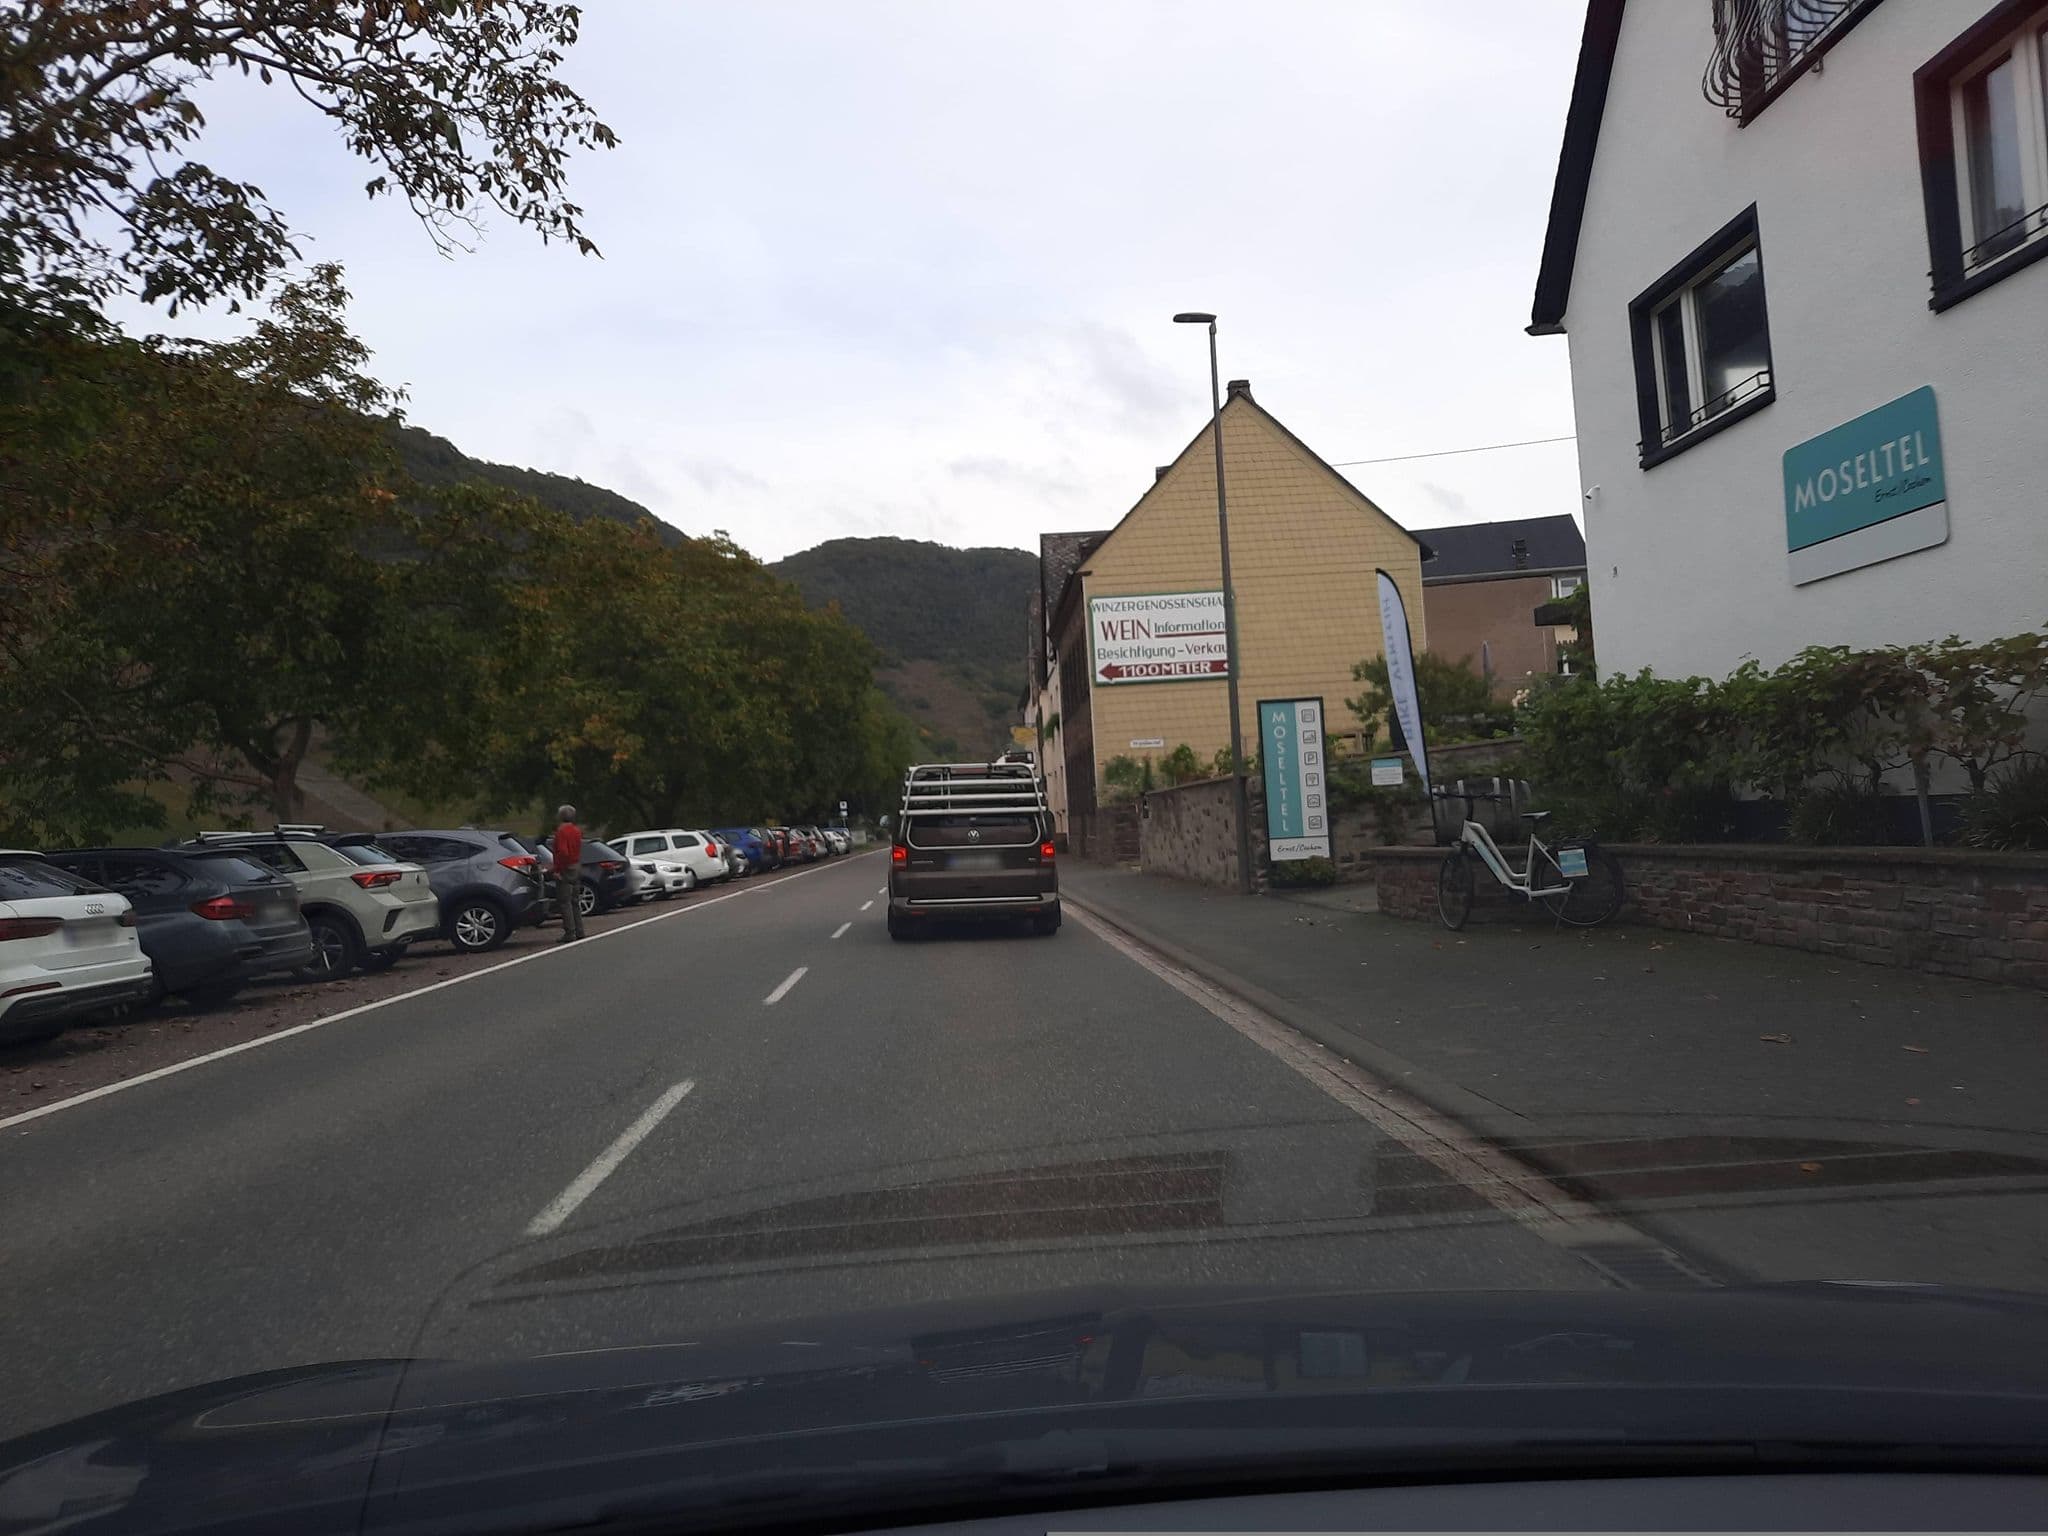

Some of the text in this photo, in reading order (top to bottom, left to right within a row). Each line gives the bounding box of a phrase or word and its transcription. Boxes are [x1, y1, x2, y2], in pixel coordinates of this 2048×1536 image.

[1795, 430, 1930, 512] MOSELTEL
[1091, 597, 1224, 613] WINZERGENOSSENSCHA
[1100, 619, 1225, 641] WEIN Information
[1185, 643, 1227, 656] Verkau
[1118, 661, 1211, 677] 1100 METER
[1272, 711, 1289, 832] MOSELTEL
